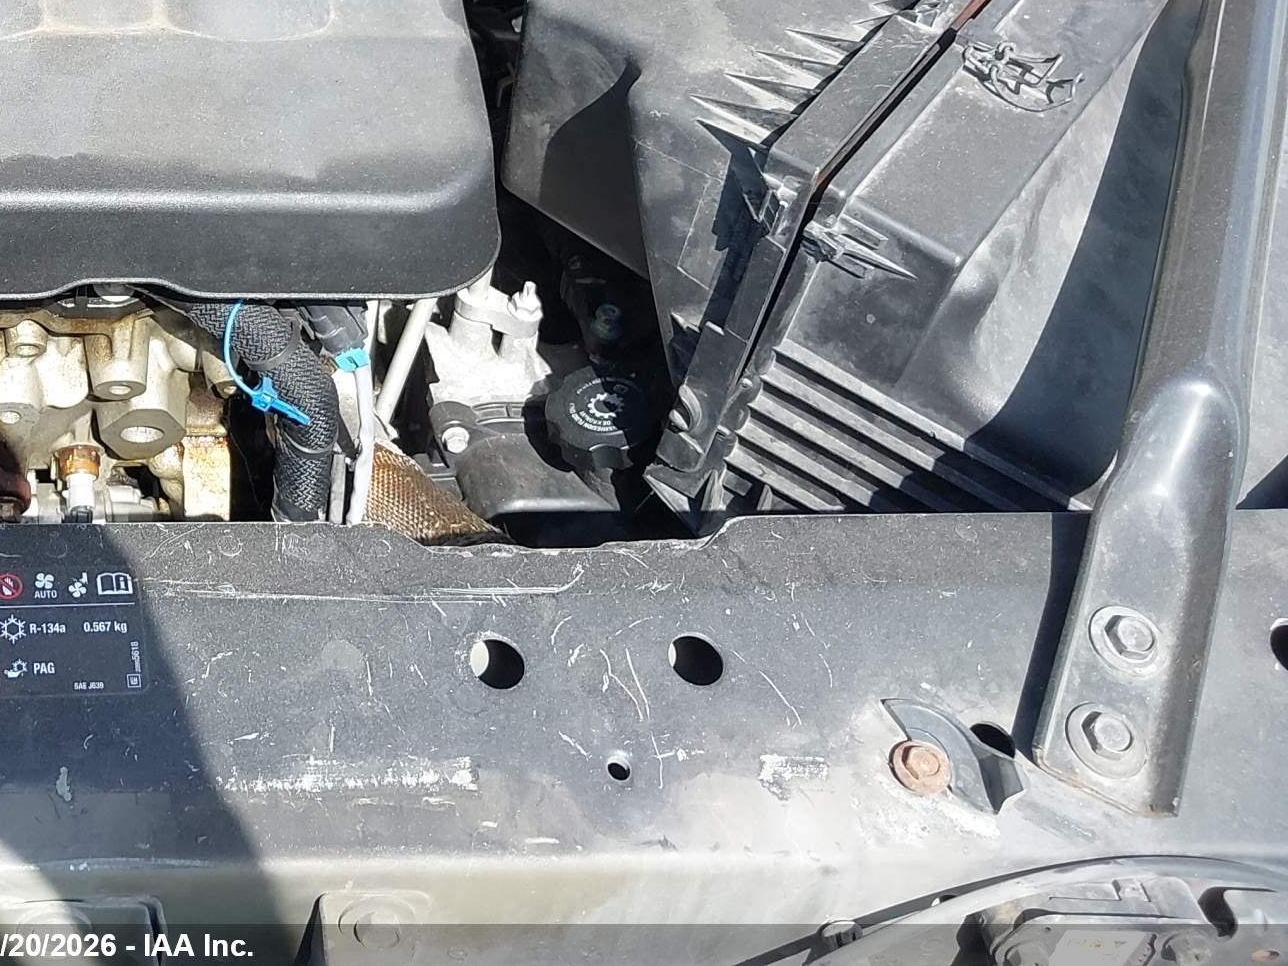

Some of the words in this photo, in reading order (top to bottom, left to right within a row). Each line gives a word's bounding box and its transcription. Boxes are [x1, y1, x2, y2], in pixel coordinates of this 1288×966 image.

[34, 589, 58, 599] AUTO
[29, 621, 67, 634] R-134a
[83, 620, 112, 634] 0.567
[114, 619, 128, 634] kg
[33, 662, 56, 675] PAG
